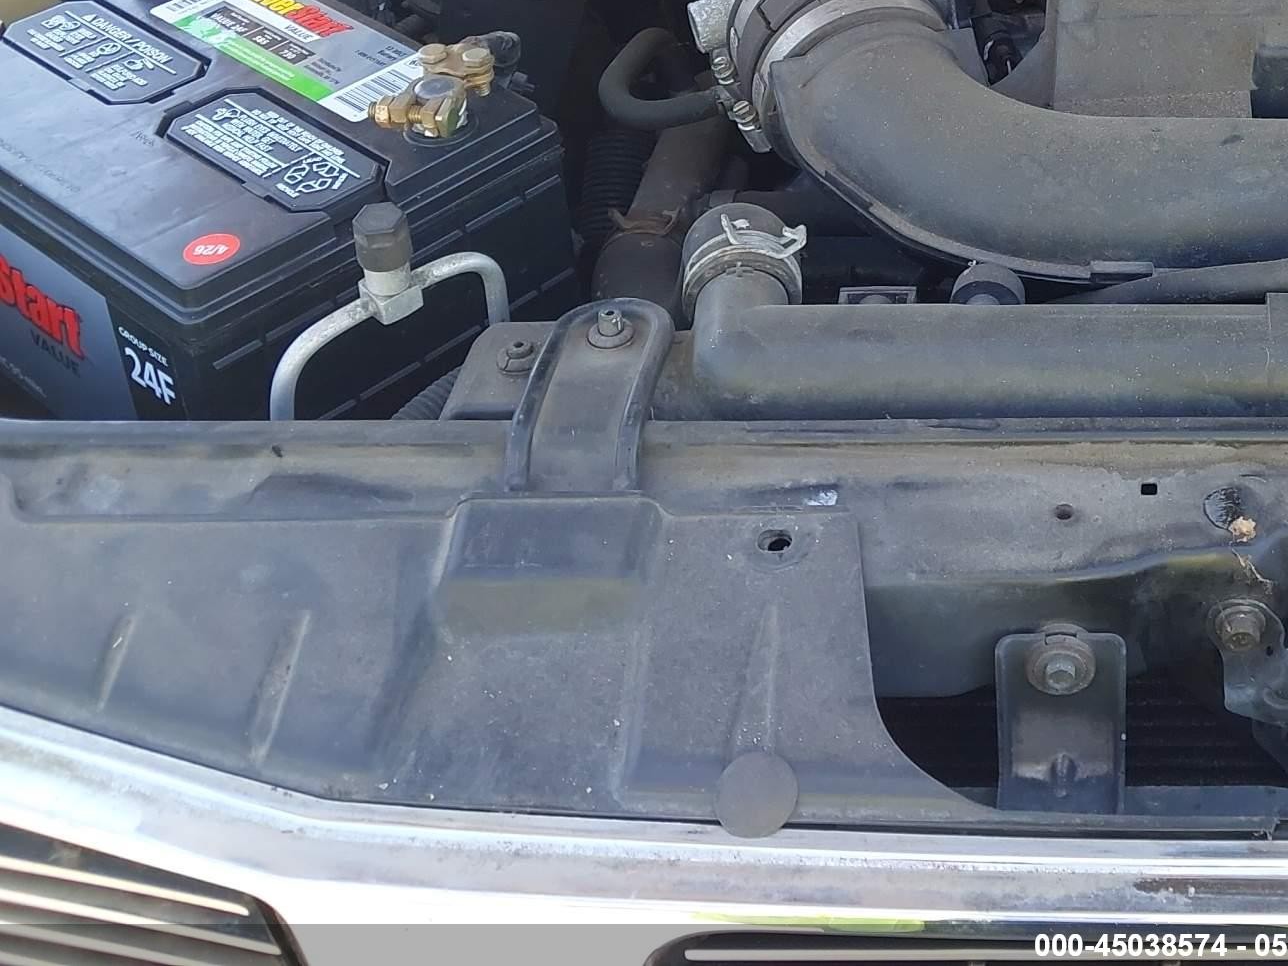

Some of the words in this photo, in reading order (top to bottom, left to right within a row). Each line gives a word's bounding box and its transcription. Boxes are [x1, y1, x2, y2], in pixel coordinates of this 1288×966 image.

[93, 16, 132, 44] DANGER
[136, 40, 173, 64] POISON
[284, 23, 314, 43] VALUE
[118, 325, 149, 352] GROUP
[147, 346, 169, 368] SIZE
[124, 346, 176, 406] 24F
